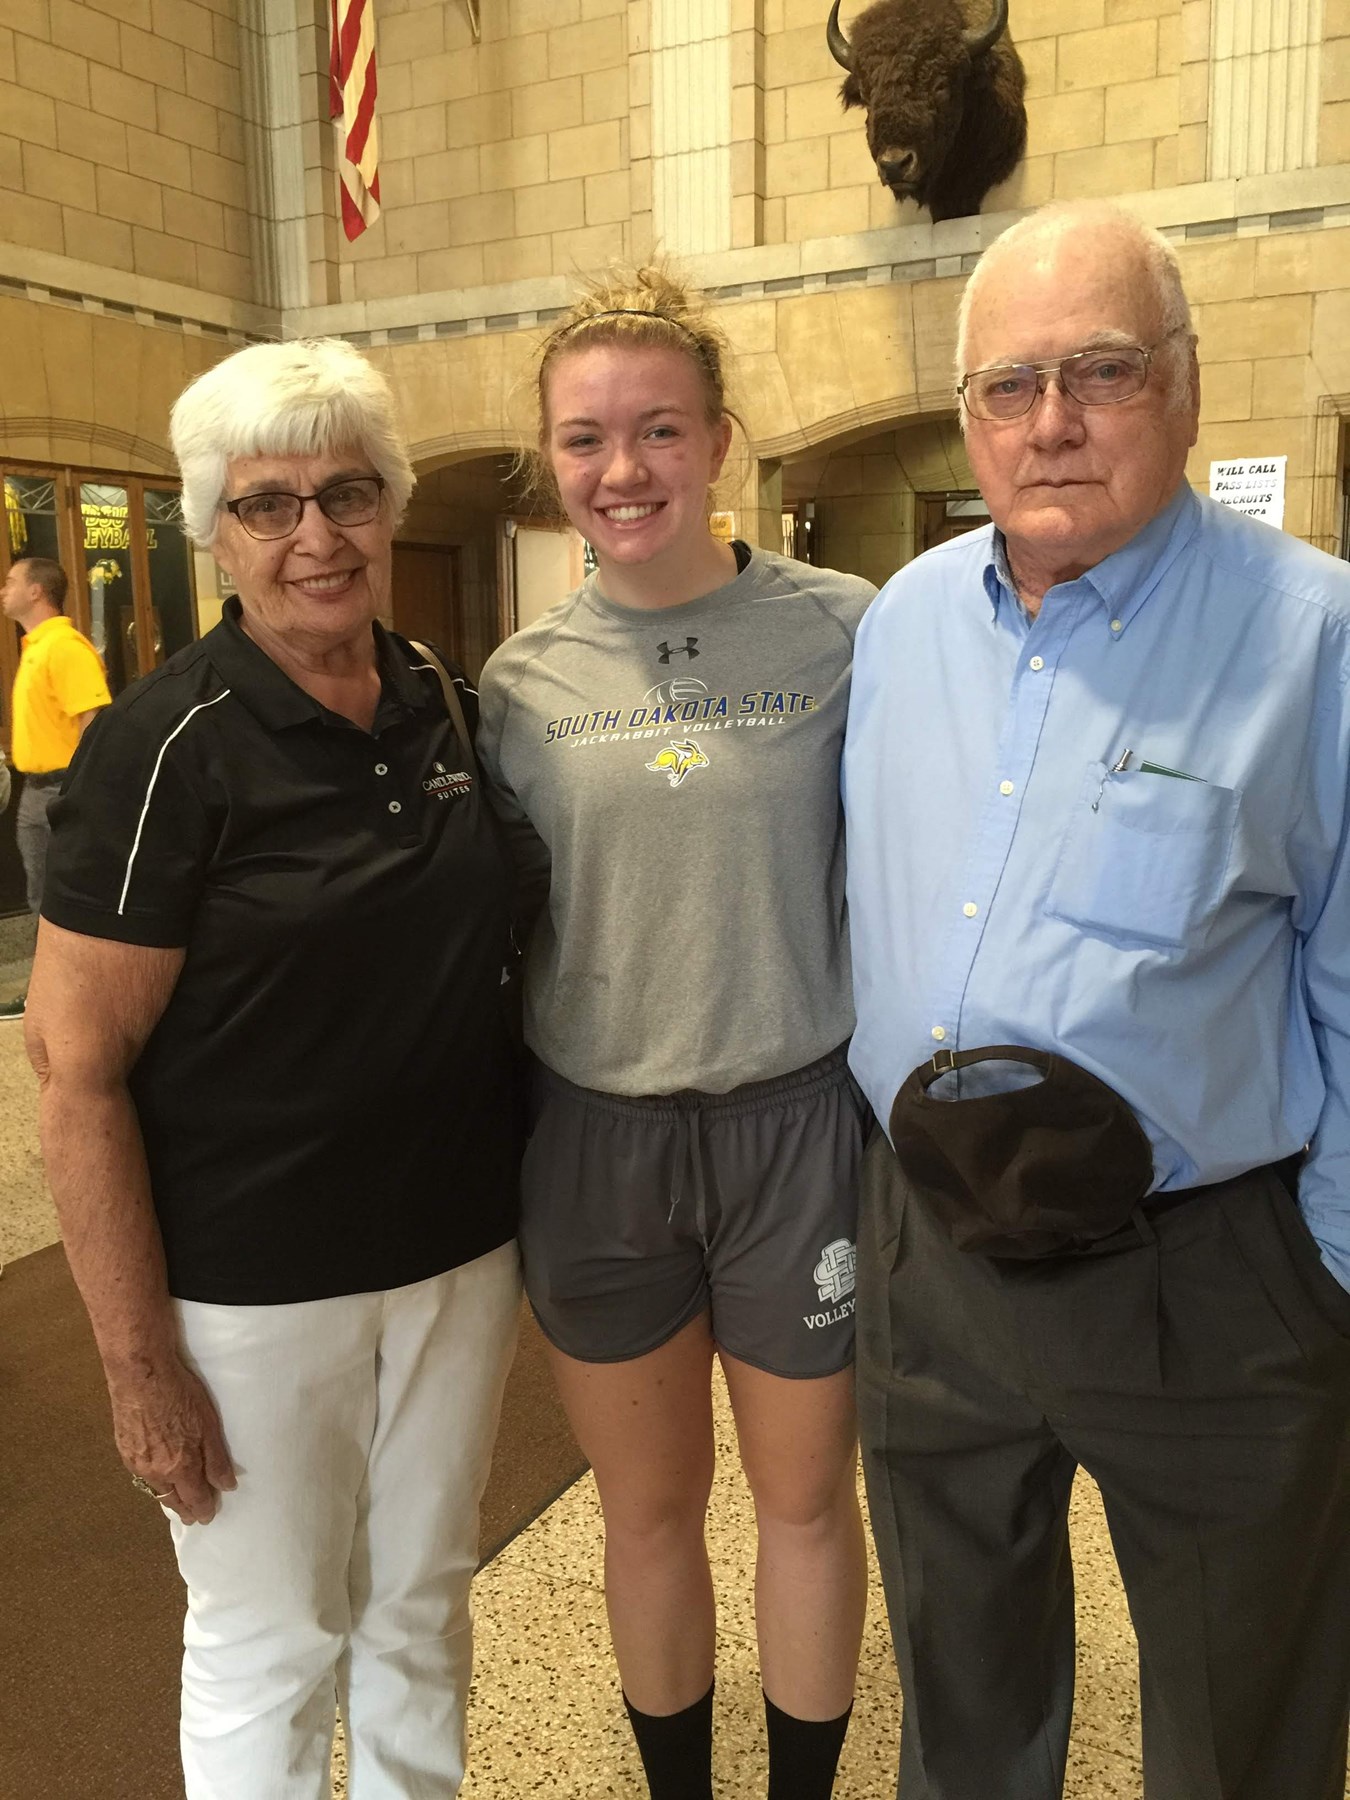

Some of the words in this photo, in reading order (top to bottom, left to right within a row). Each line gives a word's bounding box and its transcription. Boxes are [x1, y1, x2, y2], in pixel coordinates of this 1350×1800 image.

[1217, 465, 1245, 477] WILL
[1248, 463, 1277, 475] CALL
[1215, 481, 1242, 491] PASS
[1245, 478, 1278, 490] LISTS
[1220, 493, 1273, 505] RECRUITS
[544, 708, 622, 745] SOUTH
[627, 695, 728, 731] DAKOTA
[738, 690, 817, 715] STATE
[571, 727, 673, 748] JACKRABBIT
[683, 717, 786, 733] VOLLEYBALL
[437, 785, 470, 801] SUITES
